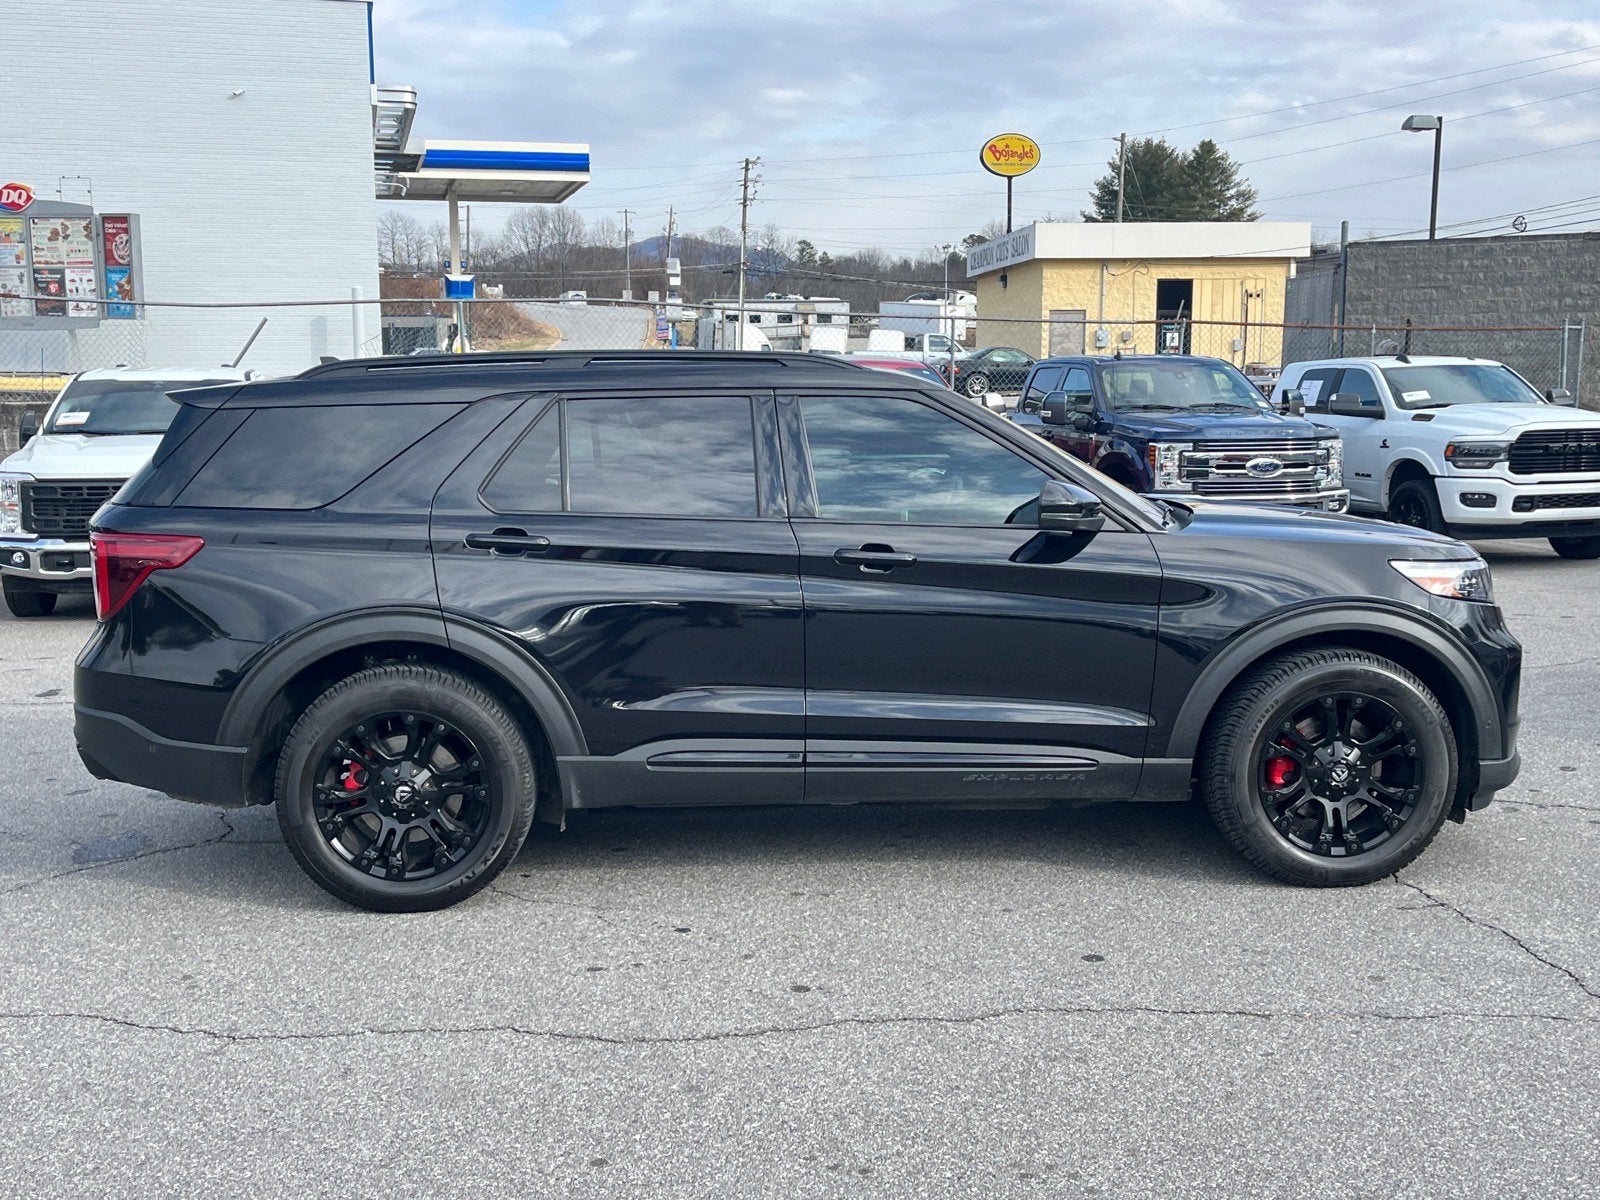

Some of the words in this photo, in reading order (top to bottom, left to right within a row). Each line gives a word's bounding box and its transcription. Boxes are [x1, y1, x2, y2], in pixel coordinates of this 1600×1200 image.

[1, 189, 28, 206] DQ
[1011, 233, 1030, 258] SALON
[963, 773, 1086, 781] EXPLORER
